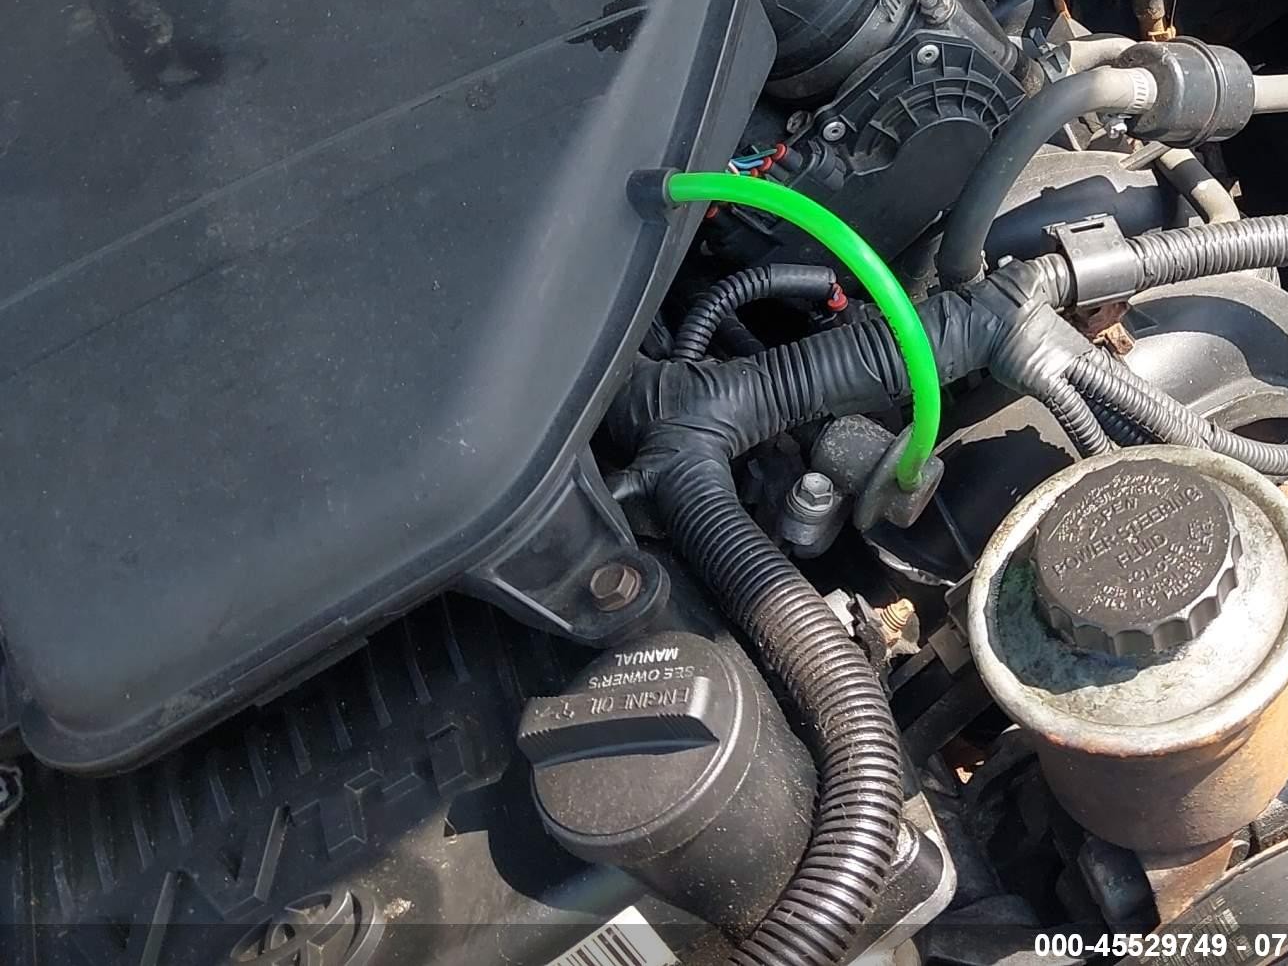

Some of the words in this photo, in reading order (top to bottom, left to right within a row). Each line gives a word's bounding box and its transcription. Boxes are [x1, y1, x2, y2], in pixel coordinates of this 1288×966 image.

[1052, 533, 1118, 576] POWER
[1117, 484, 1204, 537] STEERING
[1116, 532, 1169, 569] FLUID
[614, 646, 680, 667] MANUAL
[588, 671, 661, 690] OWNER'S
[663, 665, 696, 681] SEE
[589, 696, 615, 716] OIL
[622, 685, 691, 711] ENGINE
